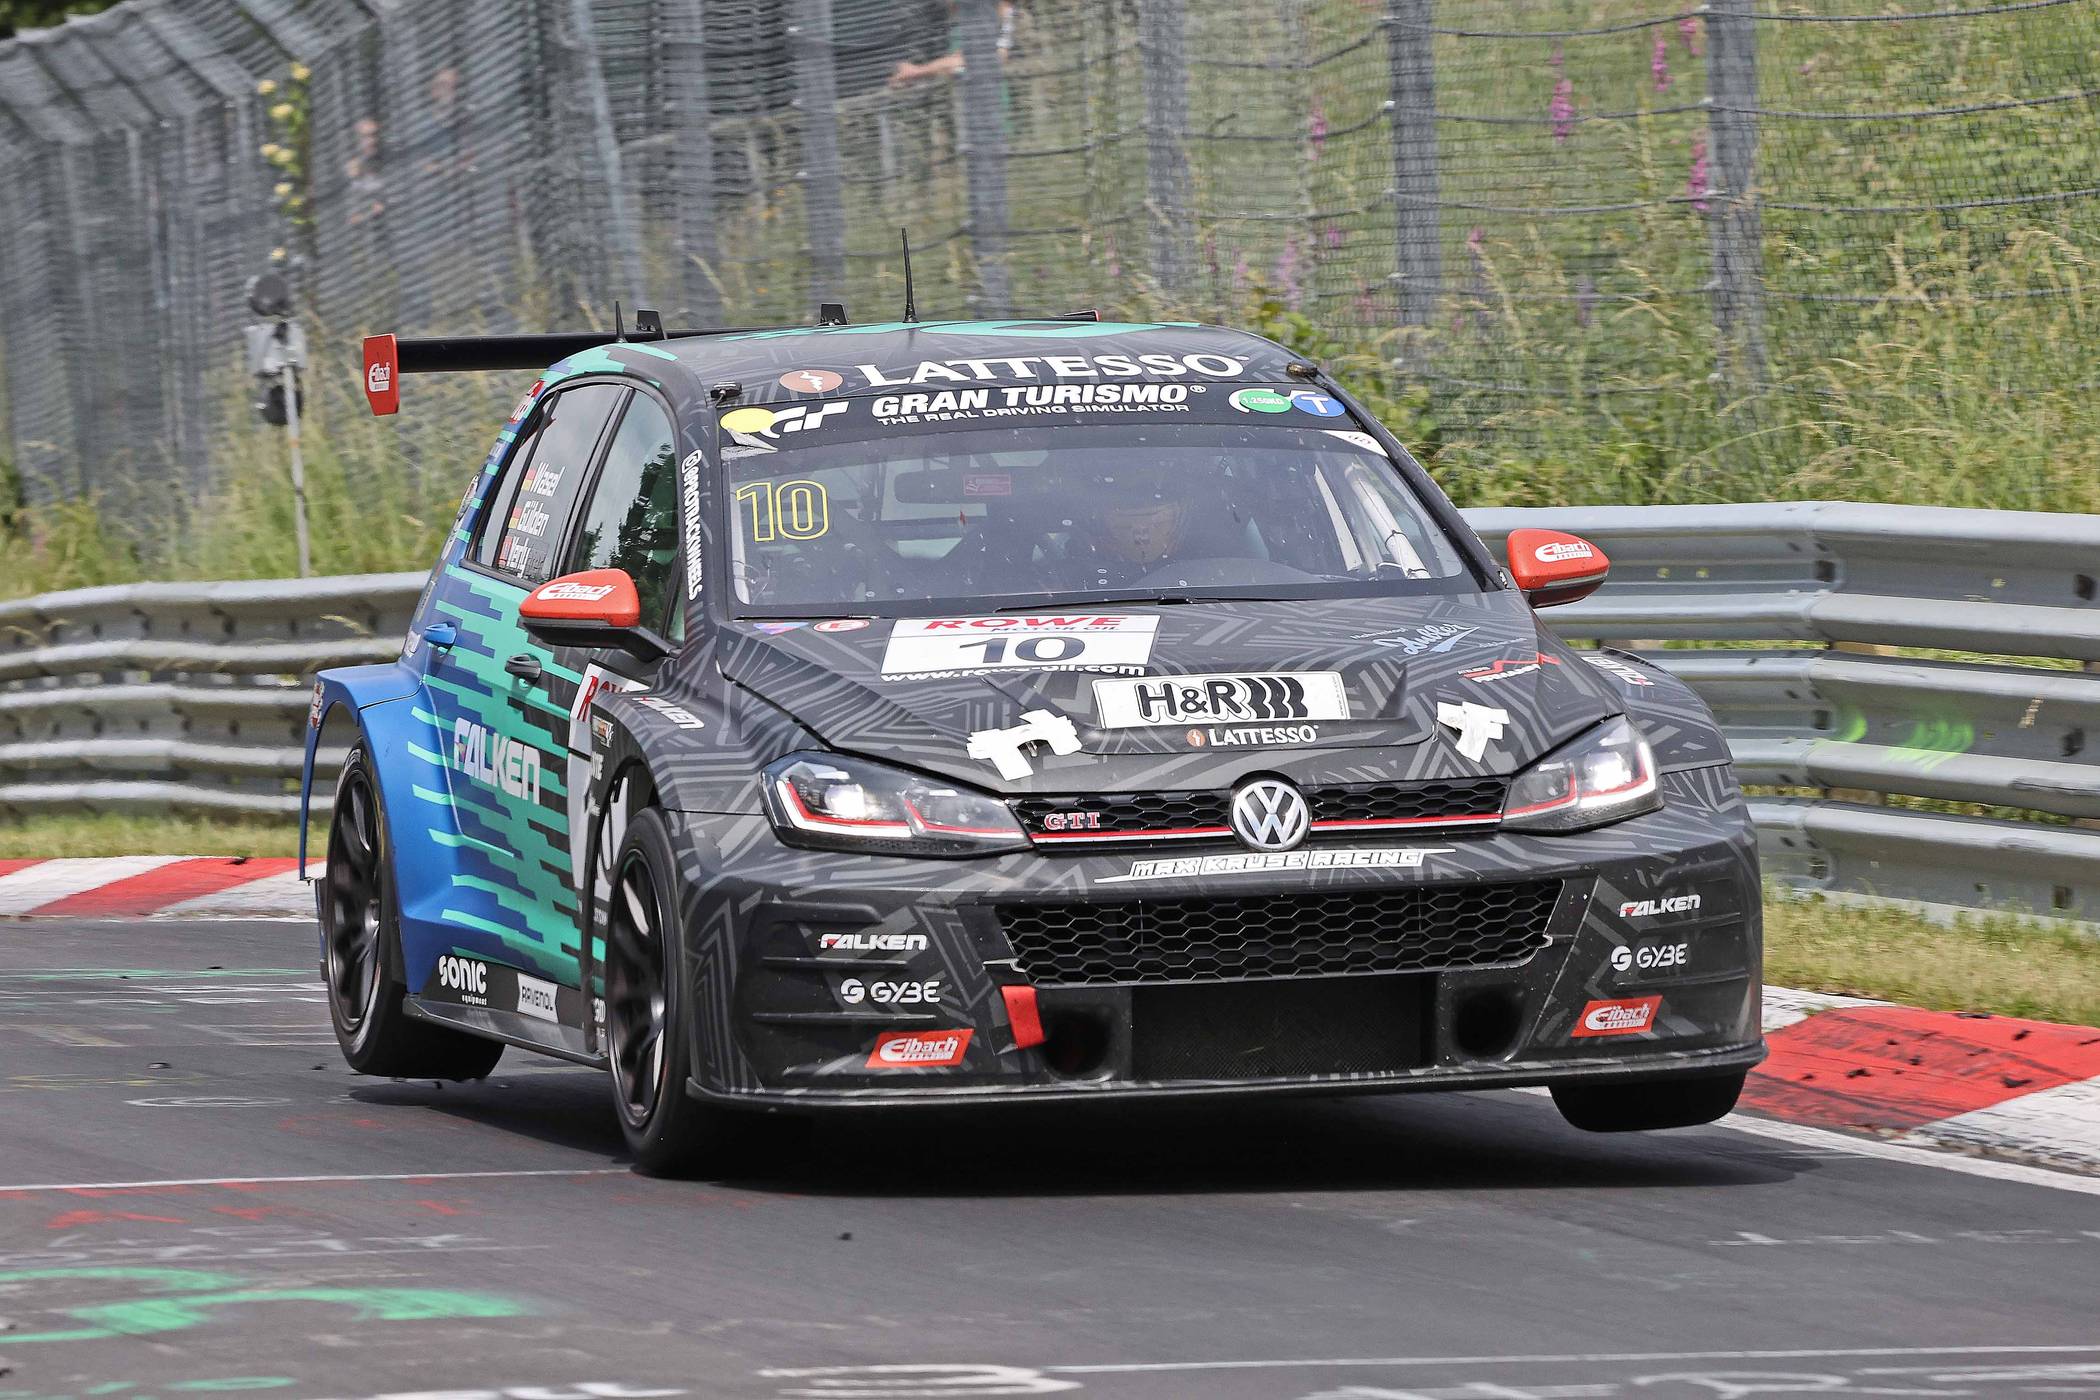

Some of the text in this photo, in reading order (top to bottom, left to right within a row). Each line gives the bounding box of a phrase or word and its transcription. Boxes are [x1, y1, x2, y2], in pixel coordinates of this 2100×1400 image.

[871, 388, 990, 418] GRAN
[875, 403, 1191, 427] THE REAL DRIVING SIMULATOR
[735, 479, 829, 542] 10
[923, 616, 1130, 630] ROWE
[958, 636, 1087, 664] 10
[1134, 679, 1246, 721] H&R
[453, 716, 541, 806] FALKEN
[1043, 812, 1101, 831] GTI
[1131, 850, 1424, 878] MAX KRUSE RACING
[1618, 894, 1701, 918] FALKEN
[819, 933, 928, 951] FALKEN
[1584, 1002, 1651, 1031] Eibach
[879, 1036, 960, 1063] Eibach
